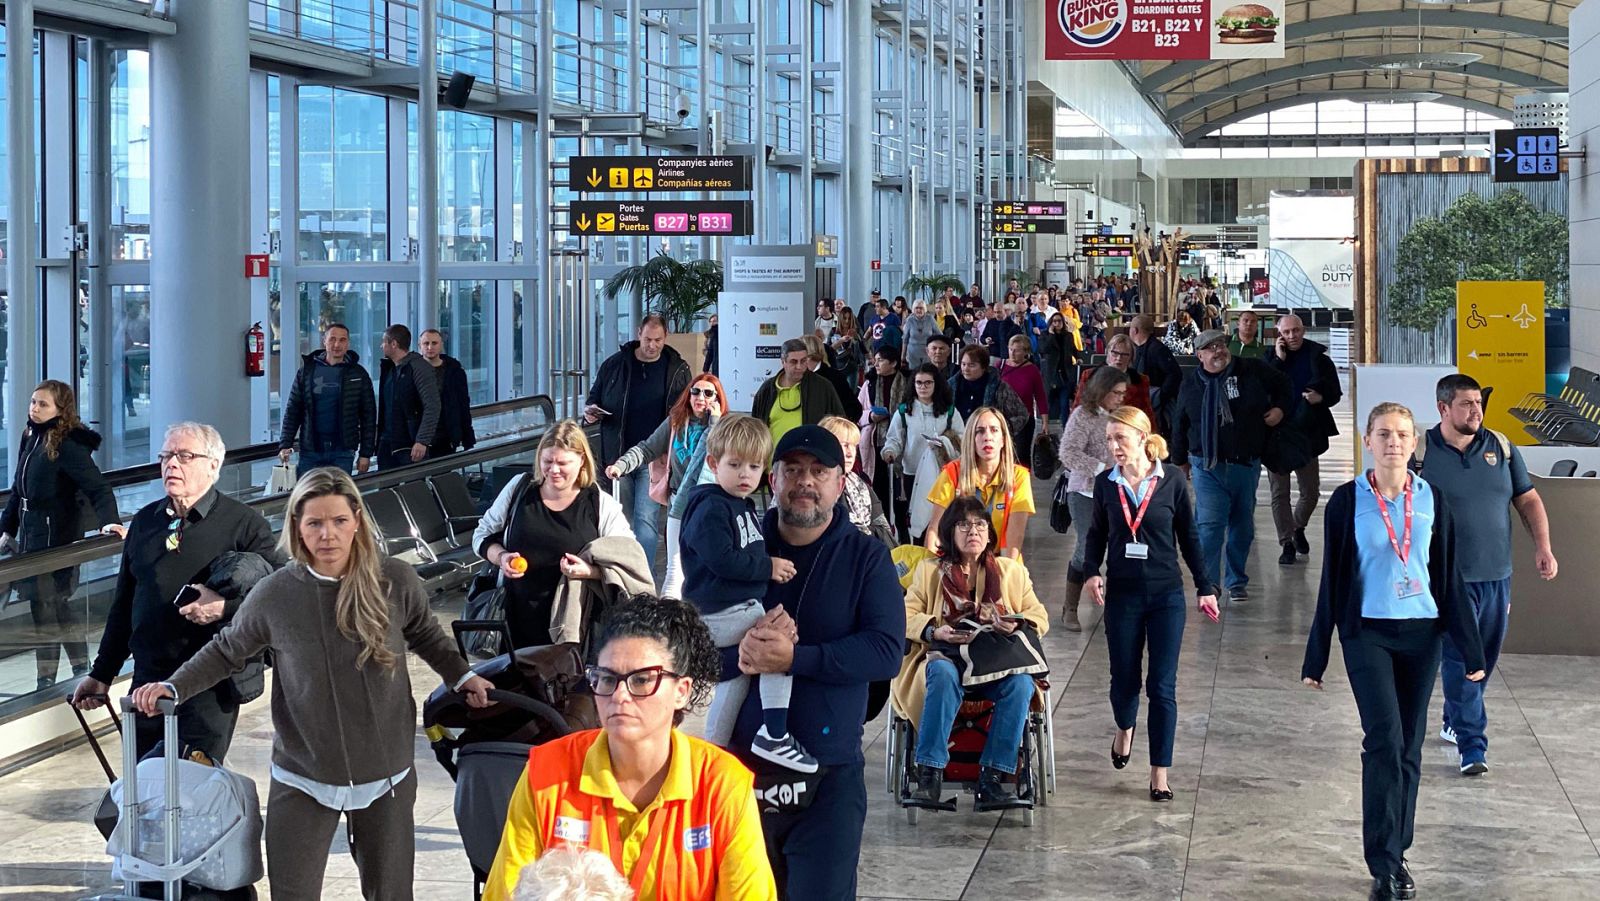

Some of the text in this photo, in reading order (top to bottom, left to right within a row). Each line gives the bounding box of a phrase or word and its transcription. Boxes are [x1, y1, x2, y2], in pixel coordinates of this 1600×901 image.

[1133, 5, 1202, 14] BOARDING GATES
[1069, 1, 1119, 32] KING
[1132, 19, 1204, 33] B21, B22 Y
[1154, 34, 1180, 47] B23
[657, 157, 734, 168] Companyies aèries
[658, 169, 685, 177] Airlines
[657, 179, 732, 188] Compañías aéreas
[619, 204, 645, 212] Portes
[619, 214, 639, 222] Gates
[689, 214, 697, 222] to
[619, 223, 650, 231] Puertas
[657, 217, 728, 229] B27 B31
[1322, 272, 1354, 282] DUTY
[736, 511, 764, 549] GA
